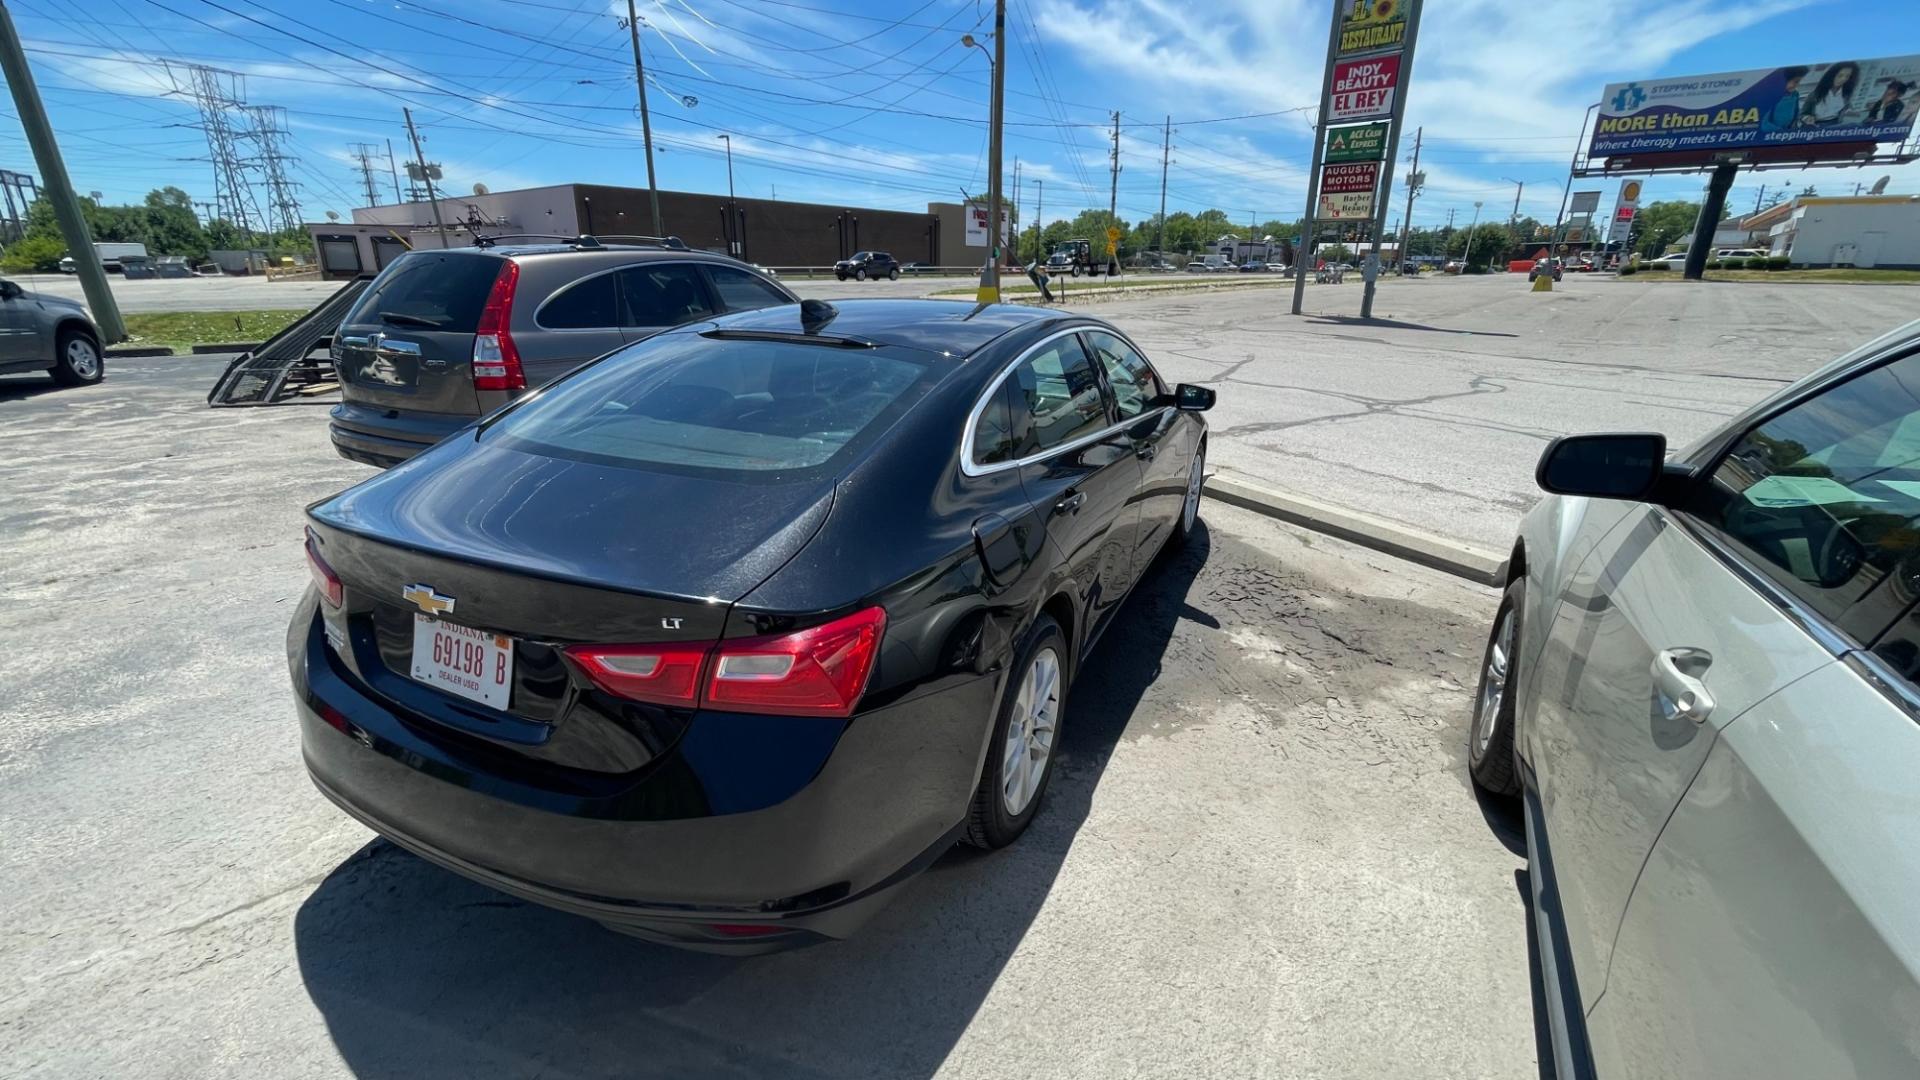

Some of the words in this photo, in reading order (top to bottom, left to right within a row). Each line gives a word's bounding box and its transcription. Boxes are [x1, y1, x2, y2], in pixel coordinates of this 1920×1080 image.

[1341, 22, 1404, 50] RESTAURANT
[1348, 62, 1383, 79] INDY
[1336, 73, 1391, 91] BEAUTY
[1651, 82, 1700, 94] STEPPING
[1701, 78, 1742, 90] STONES
[1334, 94, 1350, 111] EL
[1355, 90, 1388, 109] REY
[1600, 115, 1658, 133] MORE
[1661, 112, 1709, 128] than
[1712, 107, 1759, 125] ABA
[1349, 129, 1364, 139] ACE
[1631, 137, 1678, 149] therapy
[1679, 133, 1716, 145] meets
[1718, 131, 1758, 143] PLAY!
[1765, 126, 1910, 142] steppingstonesindy.com
[1326, 164, 1375, 175] AUGUSTA
[1327, 175, 1371, 185] MOTORS
[1343, 194, 1371, 203] Barber
[1340, 204, 1368, 213] Beauty
[441, 621, 485, 641] INDIANA
[661, 617, 684, 629] LT
[433, 632, 484, 678] 69198
[495, 652, 506, 686] B
[438, 670, 462, 686] DEALER
[463, 679, 480, 691] USED
